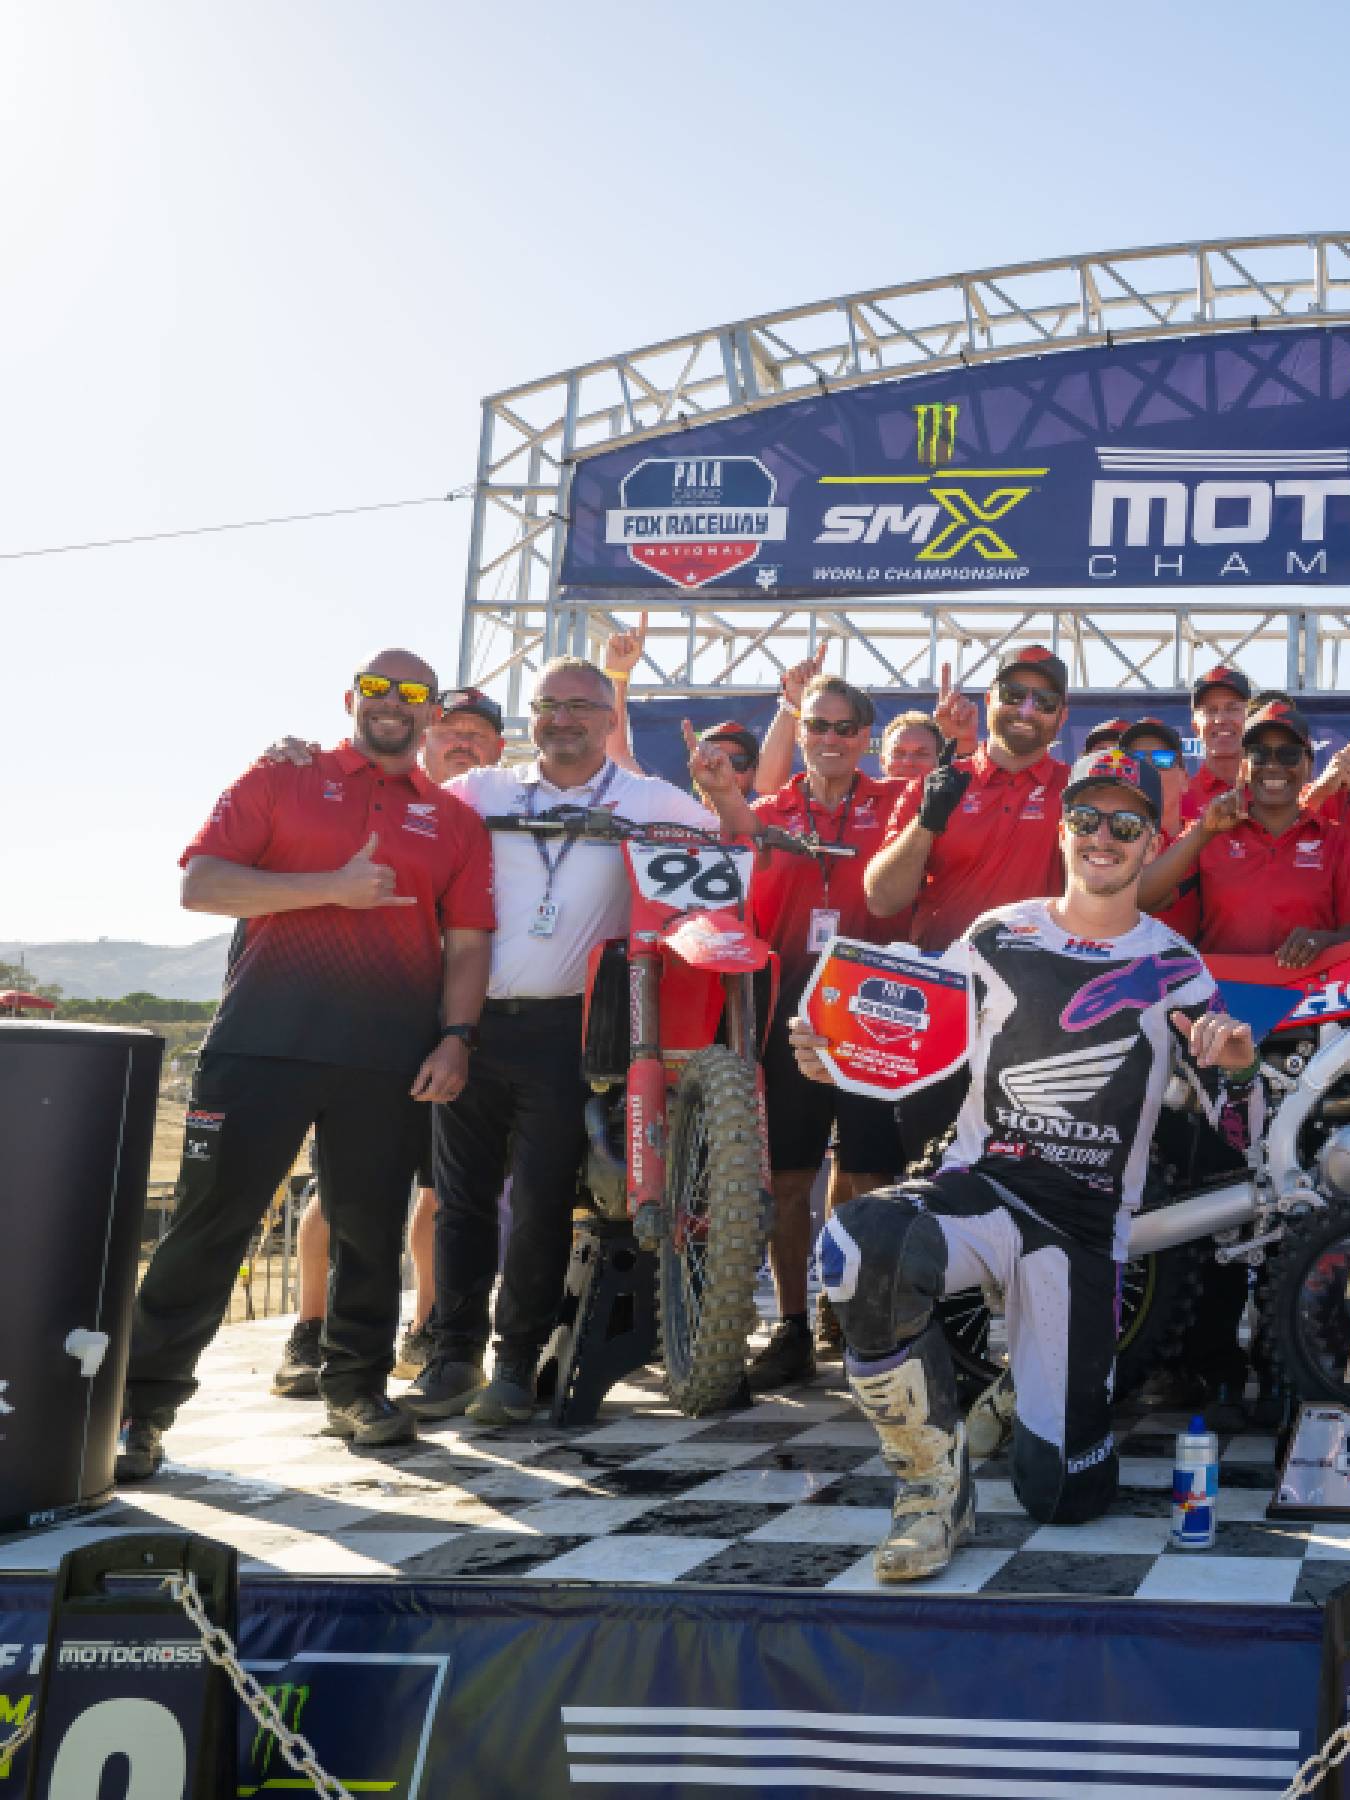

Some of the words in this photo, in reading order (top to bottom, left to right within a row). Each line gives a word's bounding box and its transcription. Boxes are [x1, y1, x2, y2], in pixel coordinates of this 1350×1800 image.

[622, 515, 662, 537] FOX
[666, 512, 769, 536] RACEWAY
[813, 487, 1031, 561] SMX
[643, 545, 745, 556] NATIONAL
[813, 566, 879, 581] WORLD
[884, 566, 1030, 582] CHAMPIONSHIP
[647, 854, 743, 901] 96
[994, 1107, 1122, 1144] HONDA
[59, 1646, 203, 1663] MOTOCROSS
